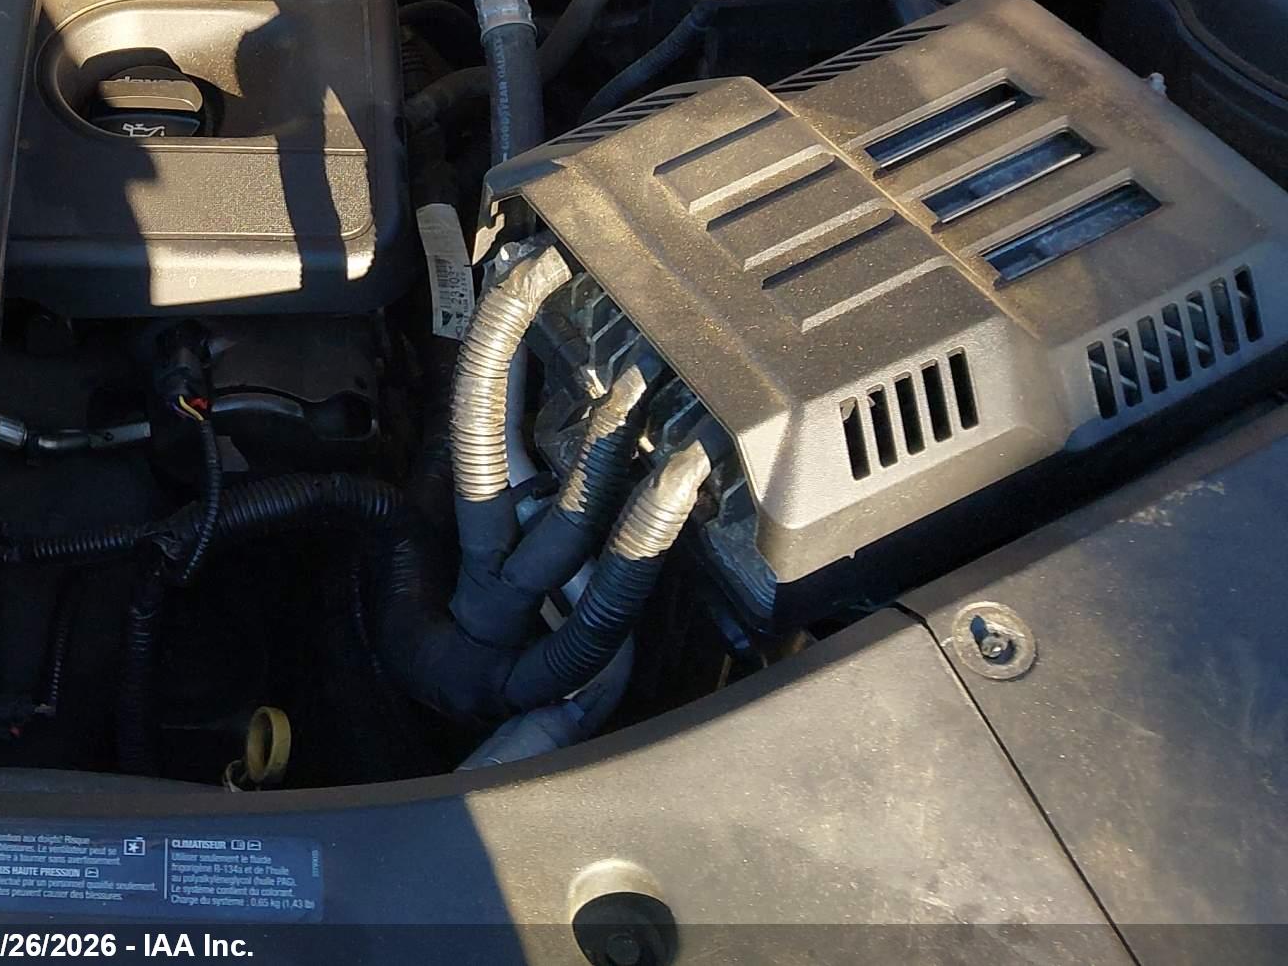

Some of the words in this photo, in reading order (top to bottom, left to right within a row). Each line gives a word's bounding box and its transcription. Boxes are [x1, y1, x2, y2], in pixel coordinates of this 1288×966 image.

[172, 840, 226, 849] CLIMATISEUR
[12, 866, 39, 875] HAUTE
[40, 867, 80, 878] PRESSION
